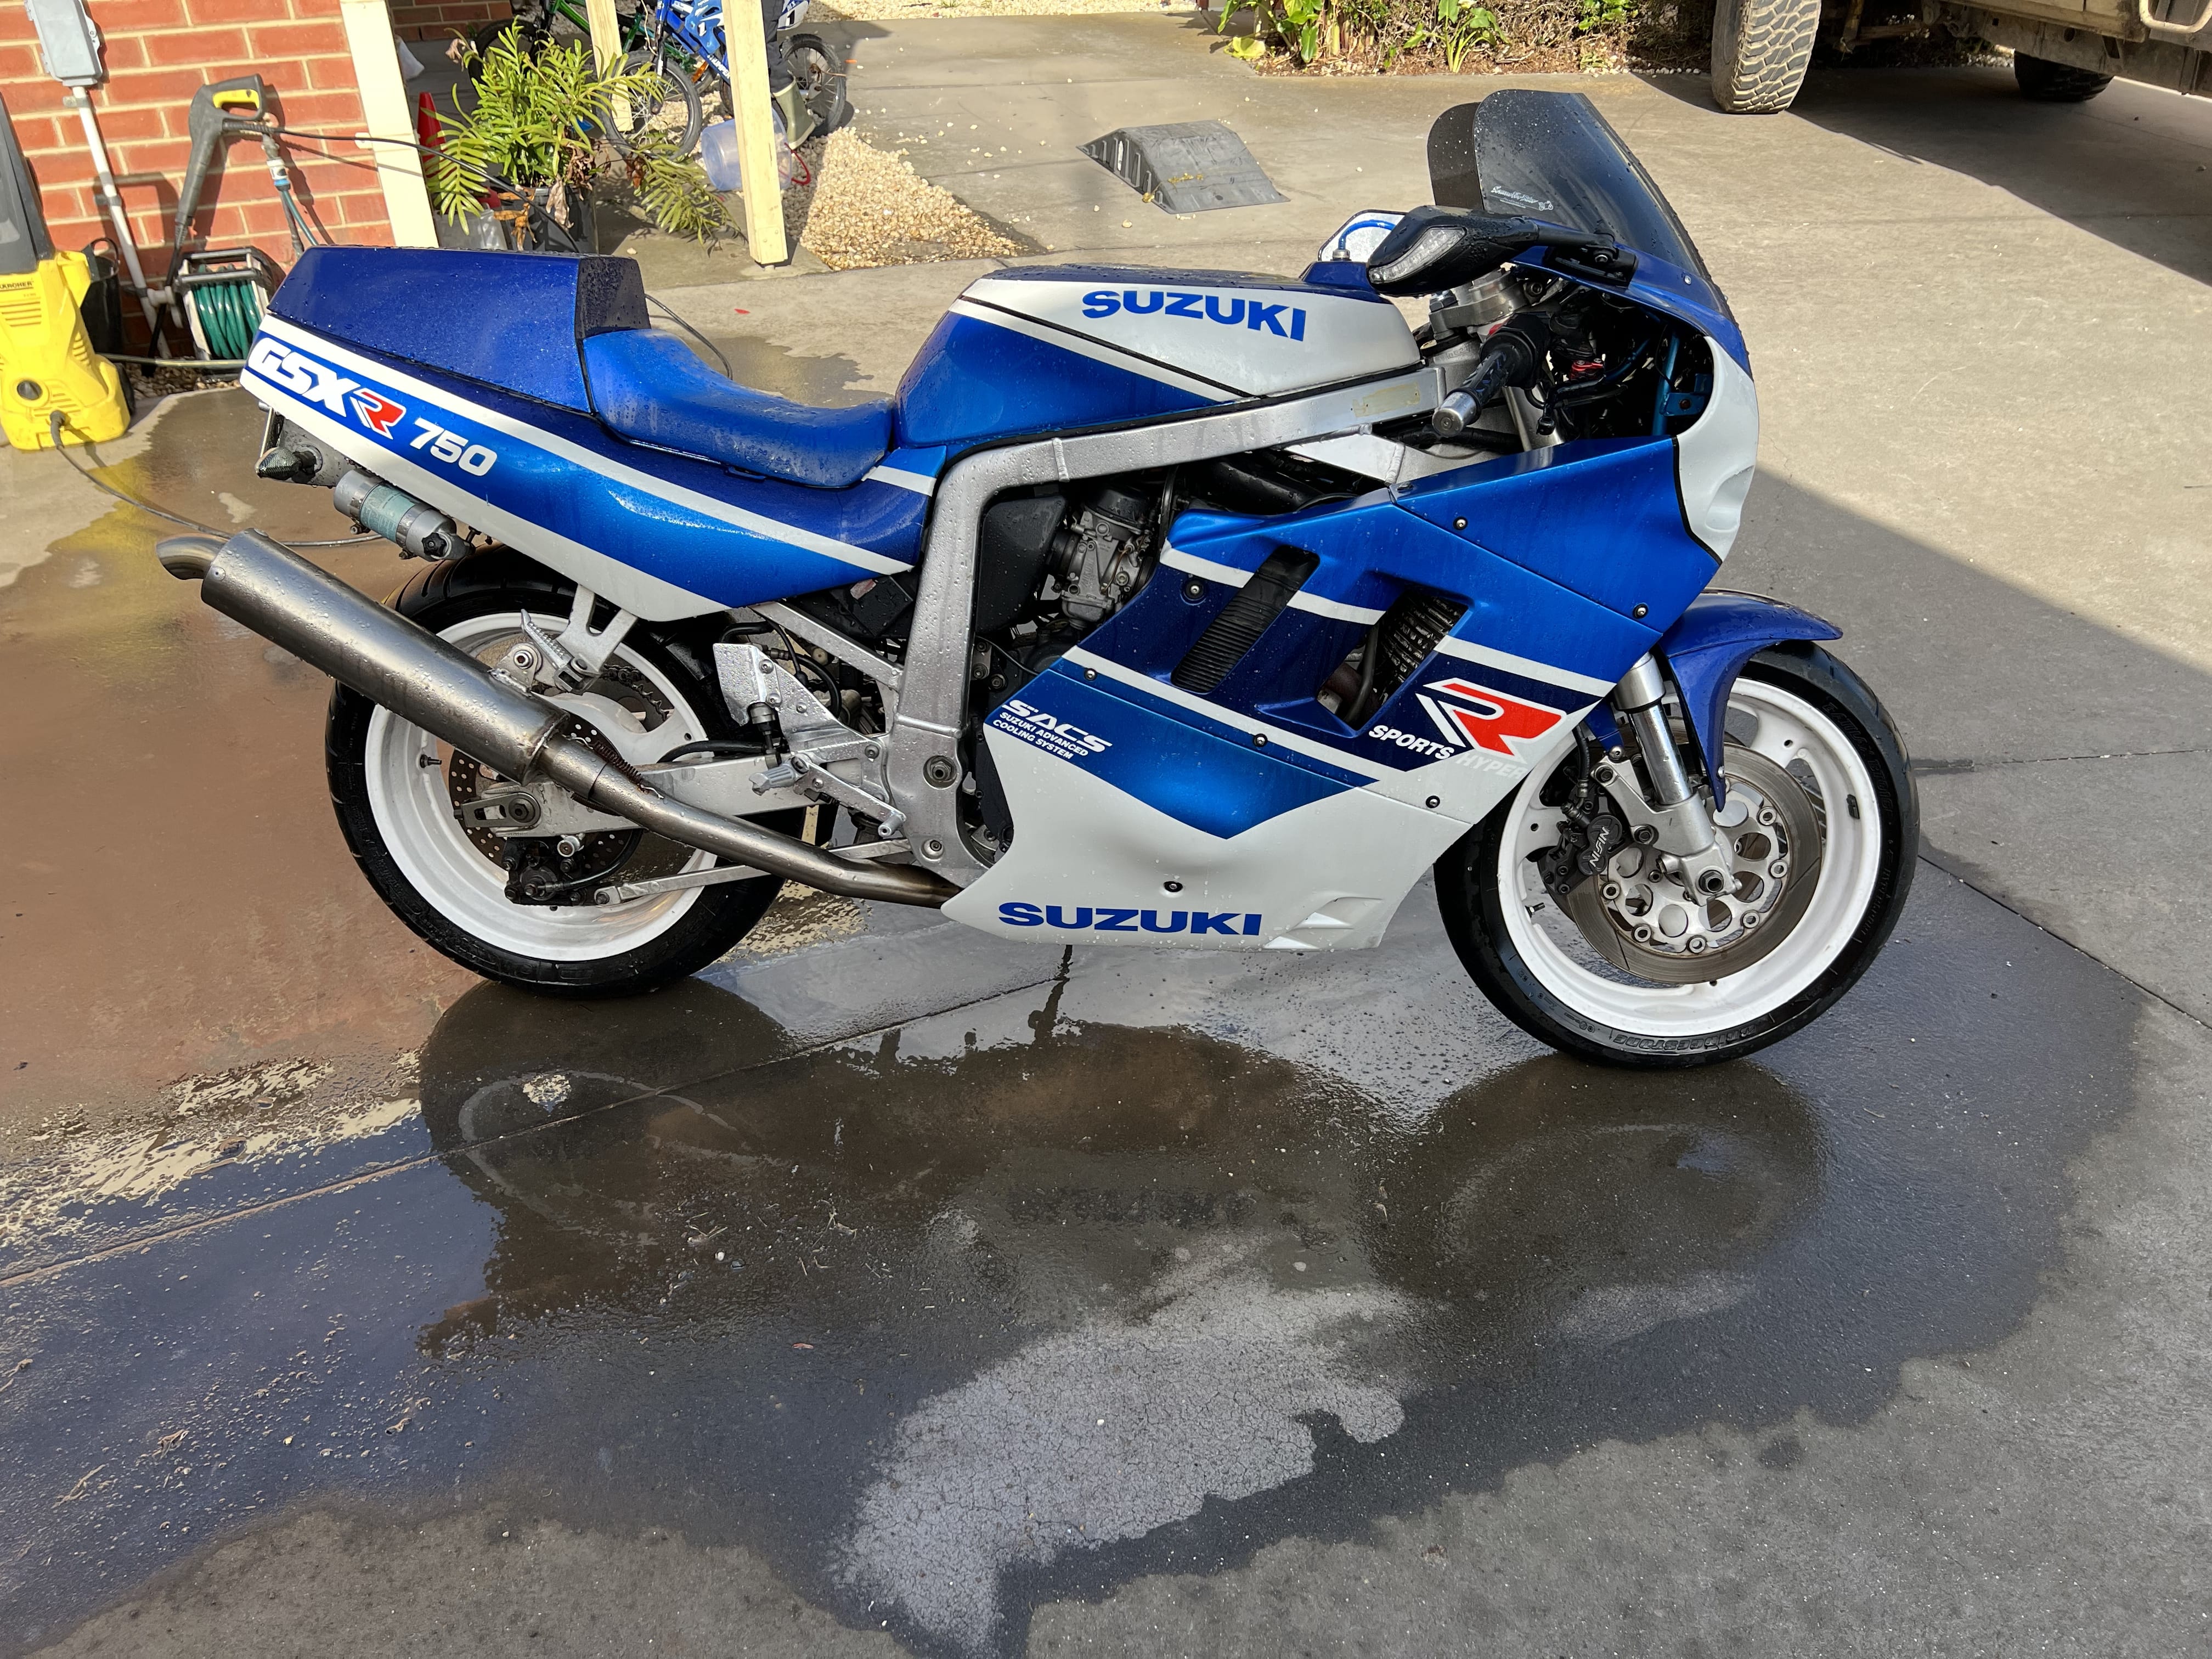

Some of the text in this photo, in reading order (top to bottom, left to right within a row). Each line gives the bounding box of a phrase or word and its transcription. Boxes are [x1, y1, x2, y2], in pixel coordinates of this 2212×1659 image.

[698, 22, 707, 36] 1
[787, 10, 795, 25] 1
[1082, 290, 1306, 341] SUZUKI
[410, 417, 498, 476] 750
[993, 719, 1074, 759] COOLING SYSTEM
[1000, 712, 1088, 757] SUZUKI ADVANCED
[1001, 699, 1113, 753] SACS
[1415, 677, 1567, 764] R
[1368, 725, 1528, 780] SPORTS HYPER
[998, 902, 1262, 936] SUZUKI
[1613, 1025, 1756, 1050] BRIDGESTONE
